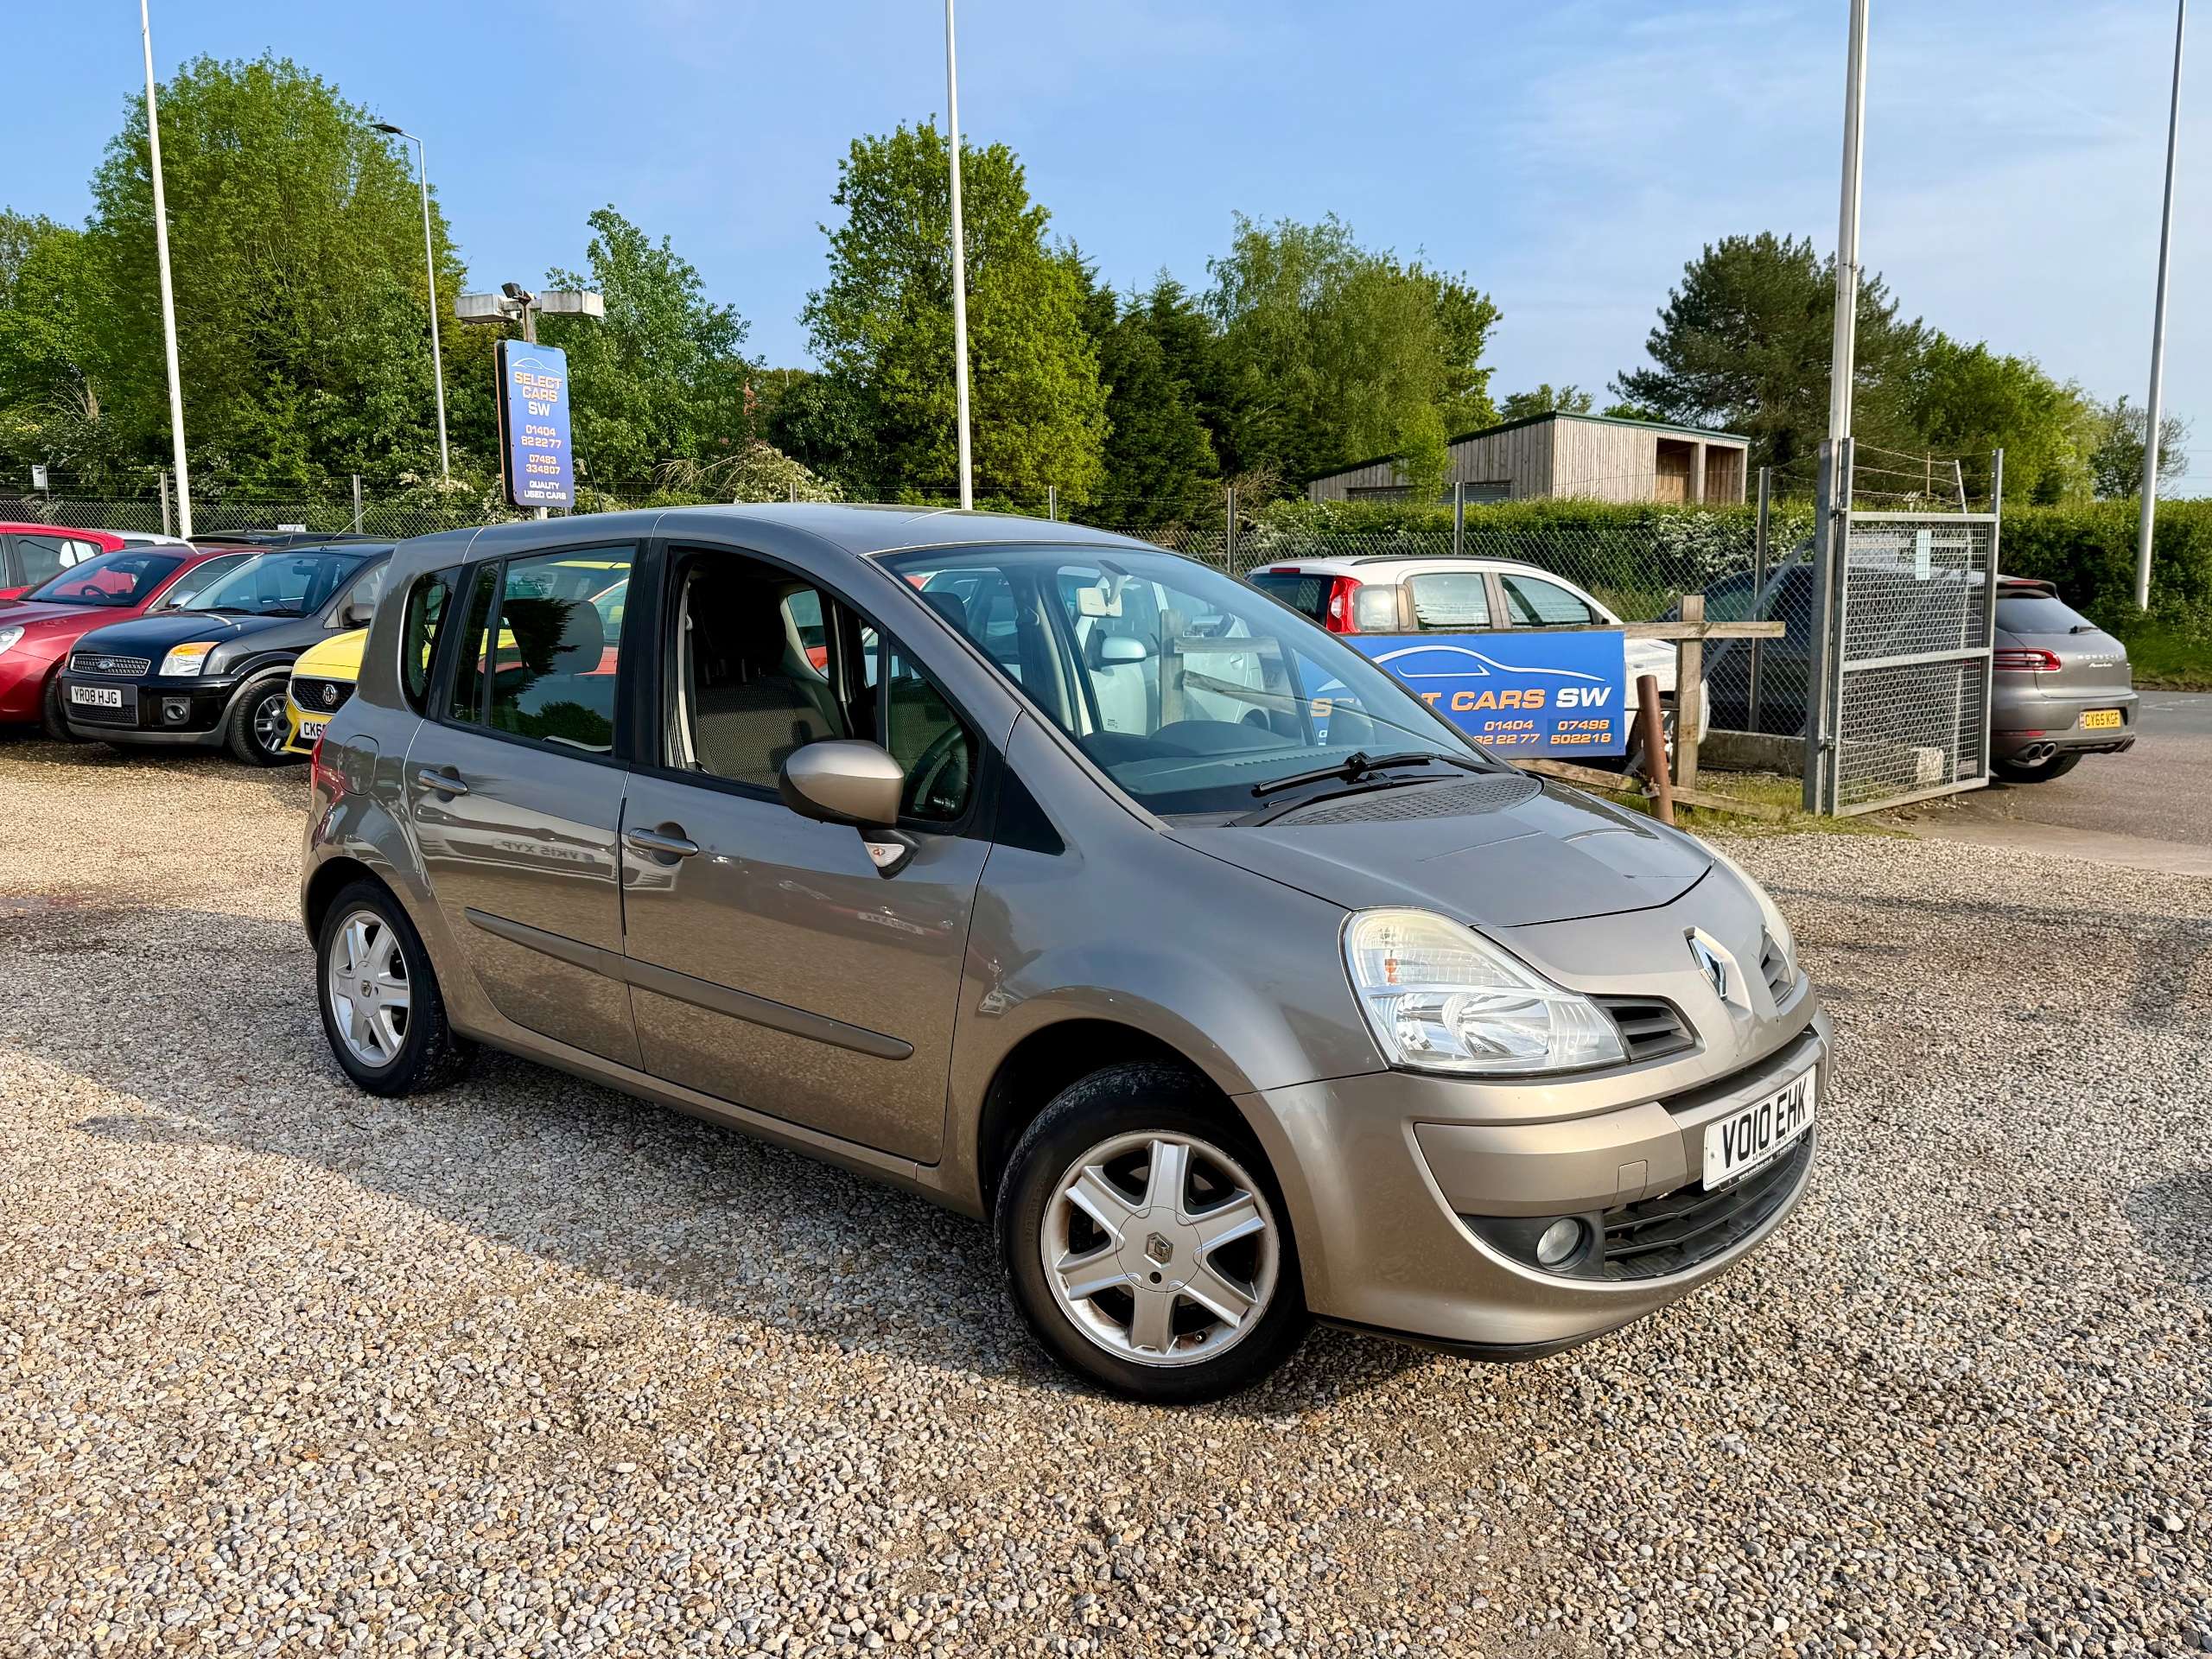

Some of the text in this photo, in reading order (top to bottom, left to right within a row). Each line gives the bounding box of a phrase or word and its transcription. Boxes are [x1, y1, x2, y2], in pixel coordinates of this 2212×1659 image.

[514, 372, 563, 390] SELECT
[522, 386, 557, 403] CARS
[528, 401, 550, 416] SW
[525, 424, 556, 436] 01404
[529, 480, 560, 490] QUALITY
[524, 490, 567, 500] USED CARS
[74, 688, 118, 704] YR08 HJG
[1452, 690, 1545, 711] CARS
[1556, 687, 1611, 708] SW
[1484, 720, 1534, 732] 01404
[1558, 719, 1609, 731] 07498
[2085, 713, 2105, 727] CY65
[1496, 734, 1517, 745] 22
[1520, 733, 1541, 744] 77
[1550, 733, 1611, 745] 502218
[1722, 1076, 1808, 1169] VO10 EHK
